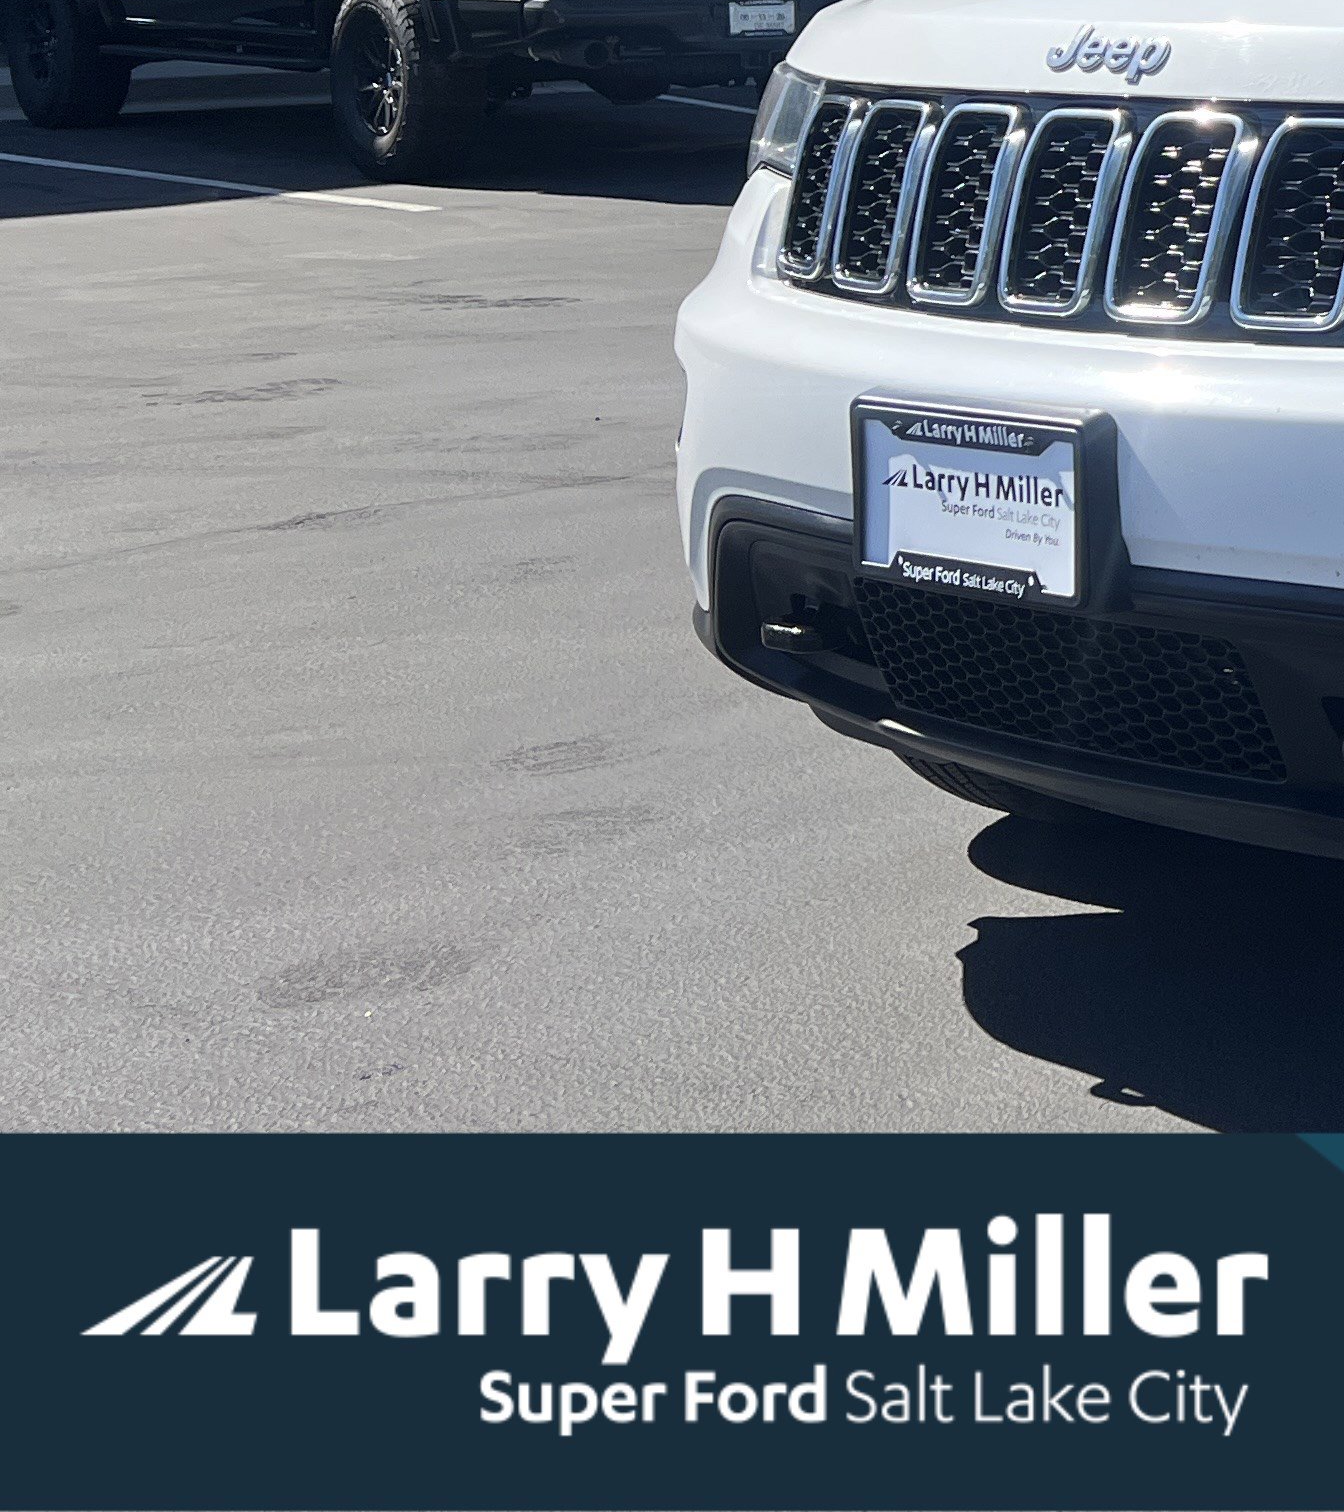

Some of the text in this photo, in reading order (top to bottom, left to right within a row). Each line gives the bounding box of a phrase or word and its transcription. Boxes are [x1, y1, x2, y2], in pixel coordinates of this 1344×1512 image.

[1046, 23, 1172, 85] Jeep
[921, 419, 1025, 449] Larry H Miller
[912, 464, 1064, 508] Larry H Miller
[941, 500, 1061, 531] Super Ford Salt Lake City
[1005, 528, 1031, 542] Driven
[902, 561, 1025, 599] Super Ford Salt Lake City
